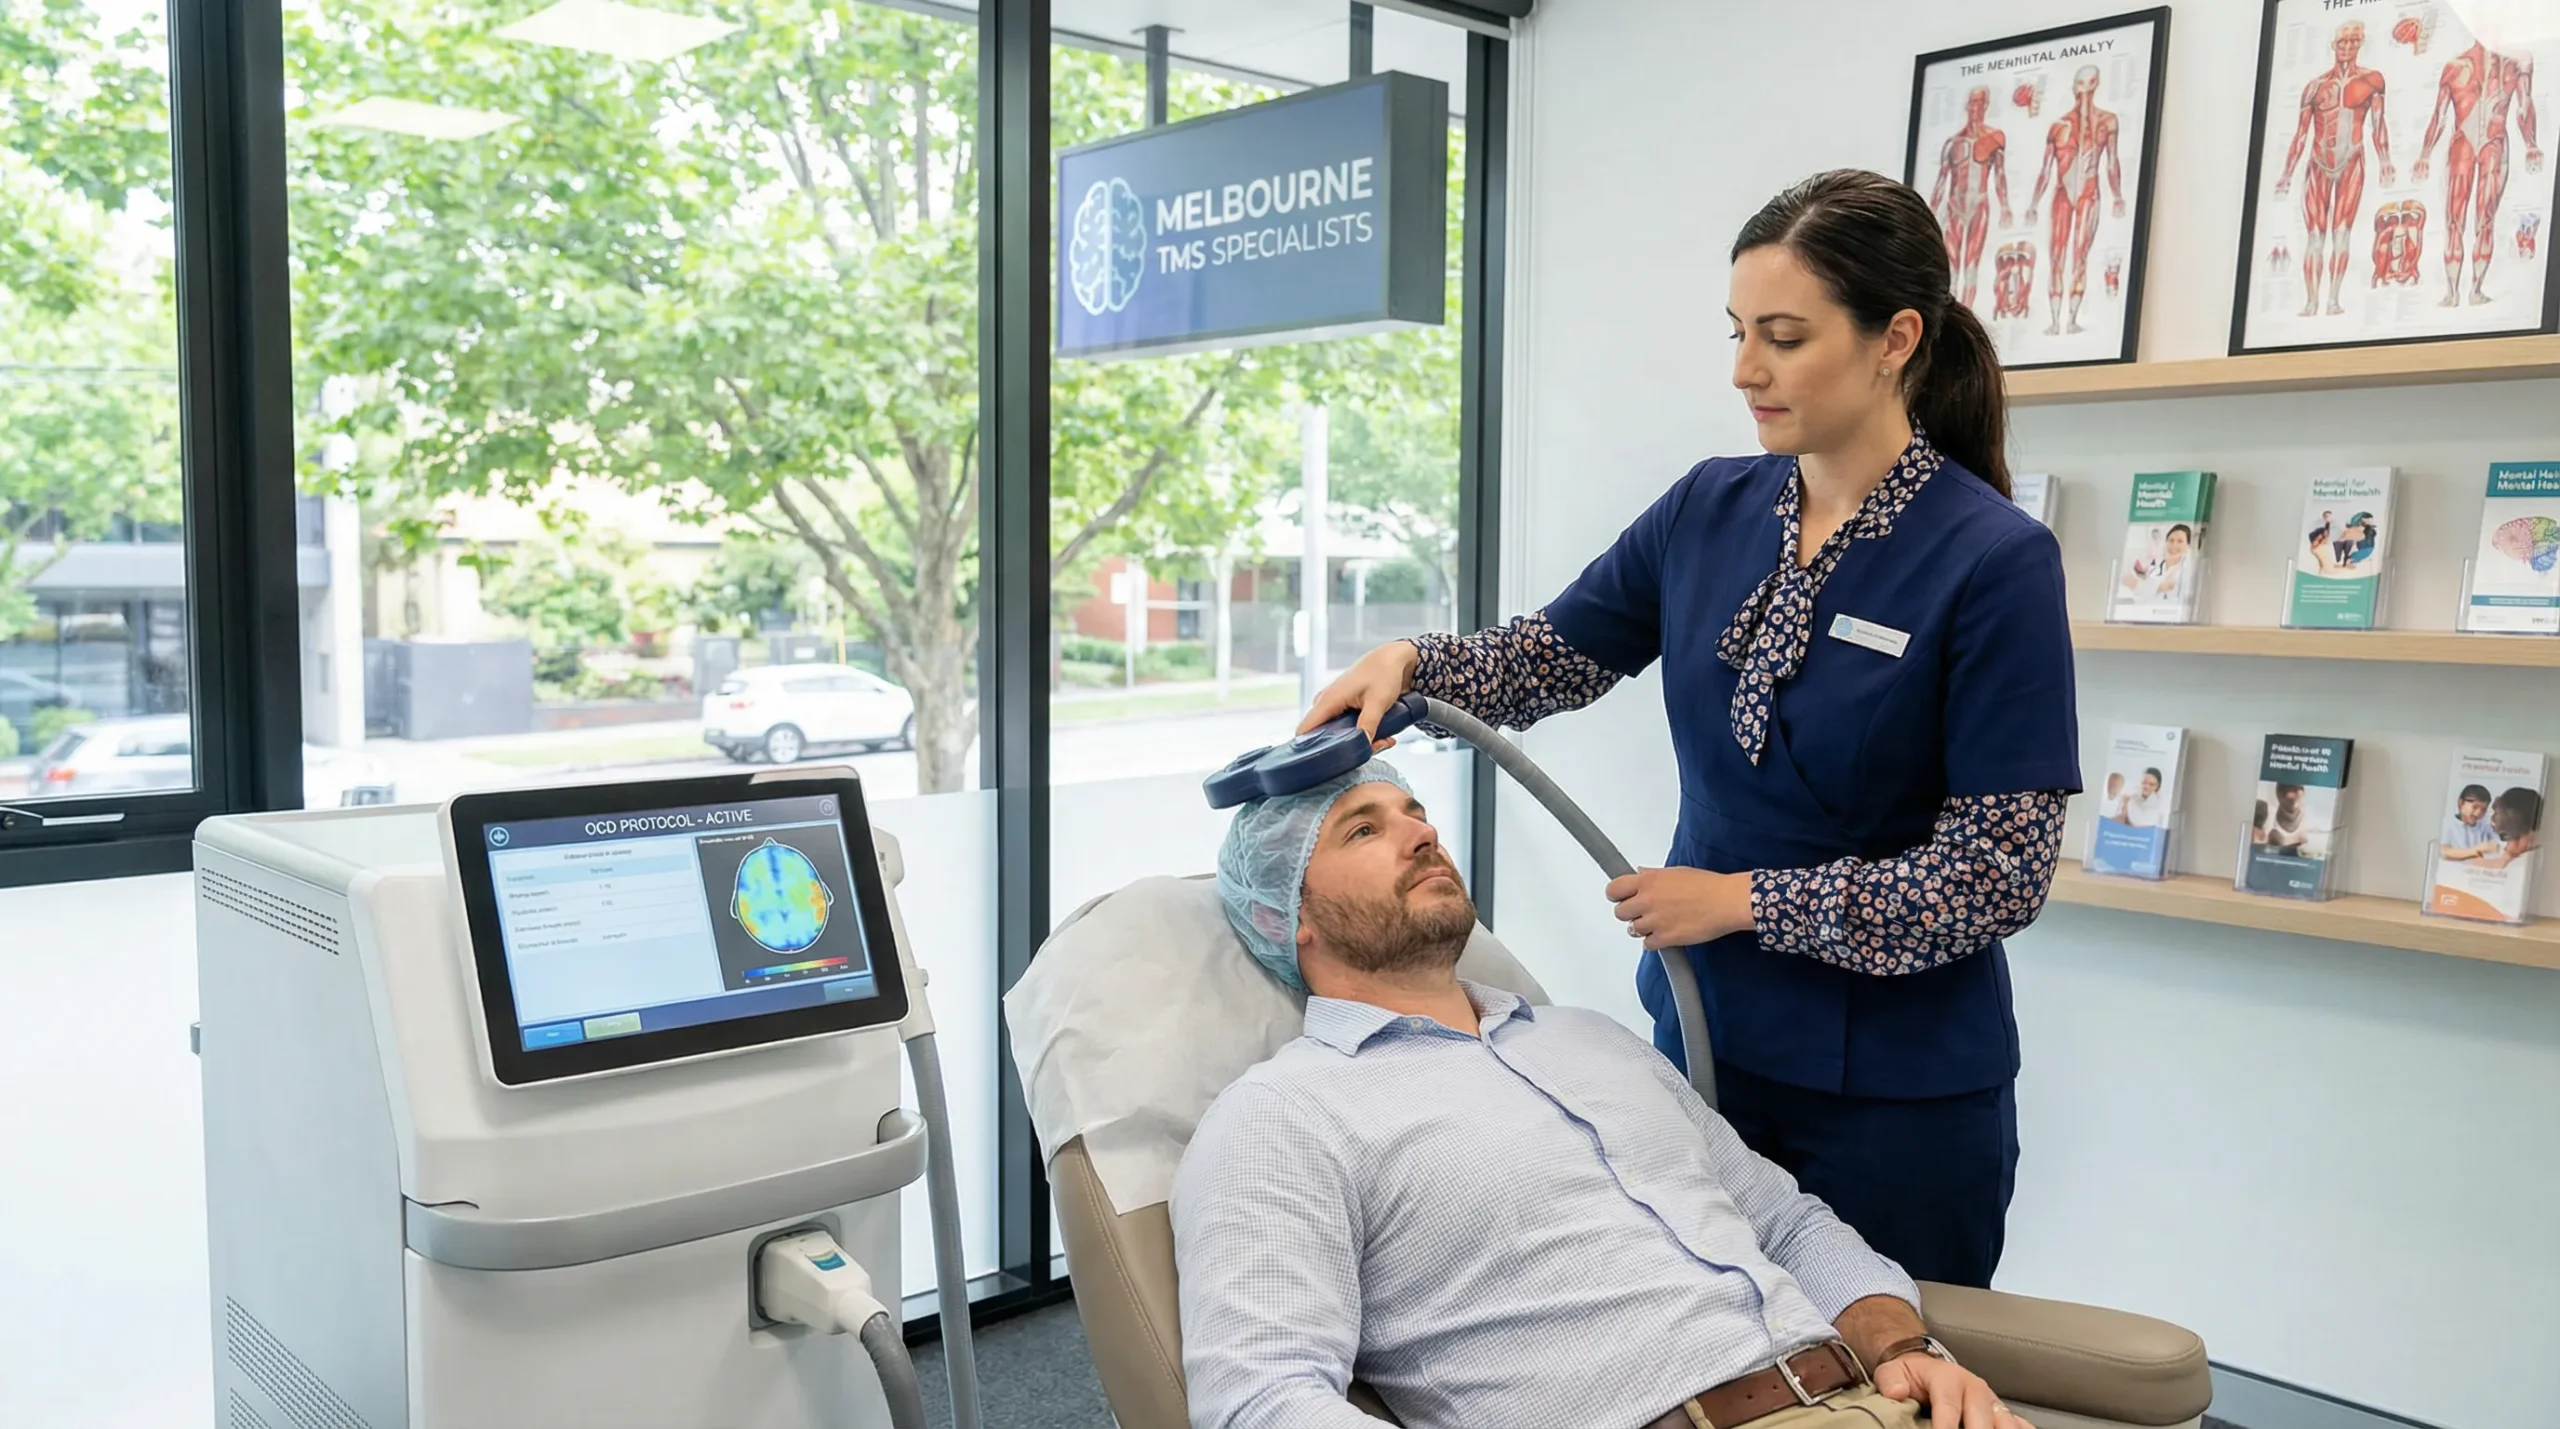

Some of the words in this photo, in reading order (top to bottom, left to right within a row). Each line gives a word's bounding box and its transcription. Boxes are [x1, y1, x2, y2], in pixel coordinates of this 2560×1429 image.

[1960, 63, 1984, 77] THE
[1156, 157, 1374, 237] MELBOURNE
[1156, 240, 1206, 275] TMS
[1212, 211, 1373, 265] SPECIALISTS
[585, 821, 617, 836] OCD
[620, 813, 696, 833] PROTOCOL
[706, 809, 753, 825] ACTIVE
